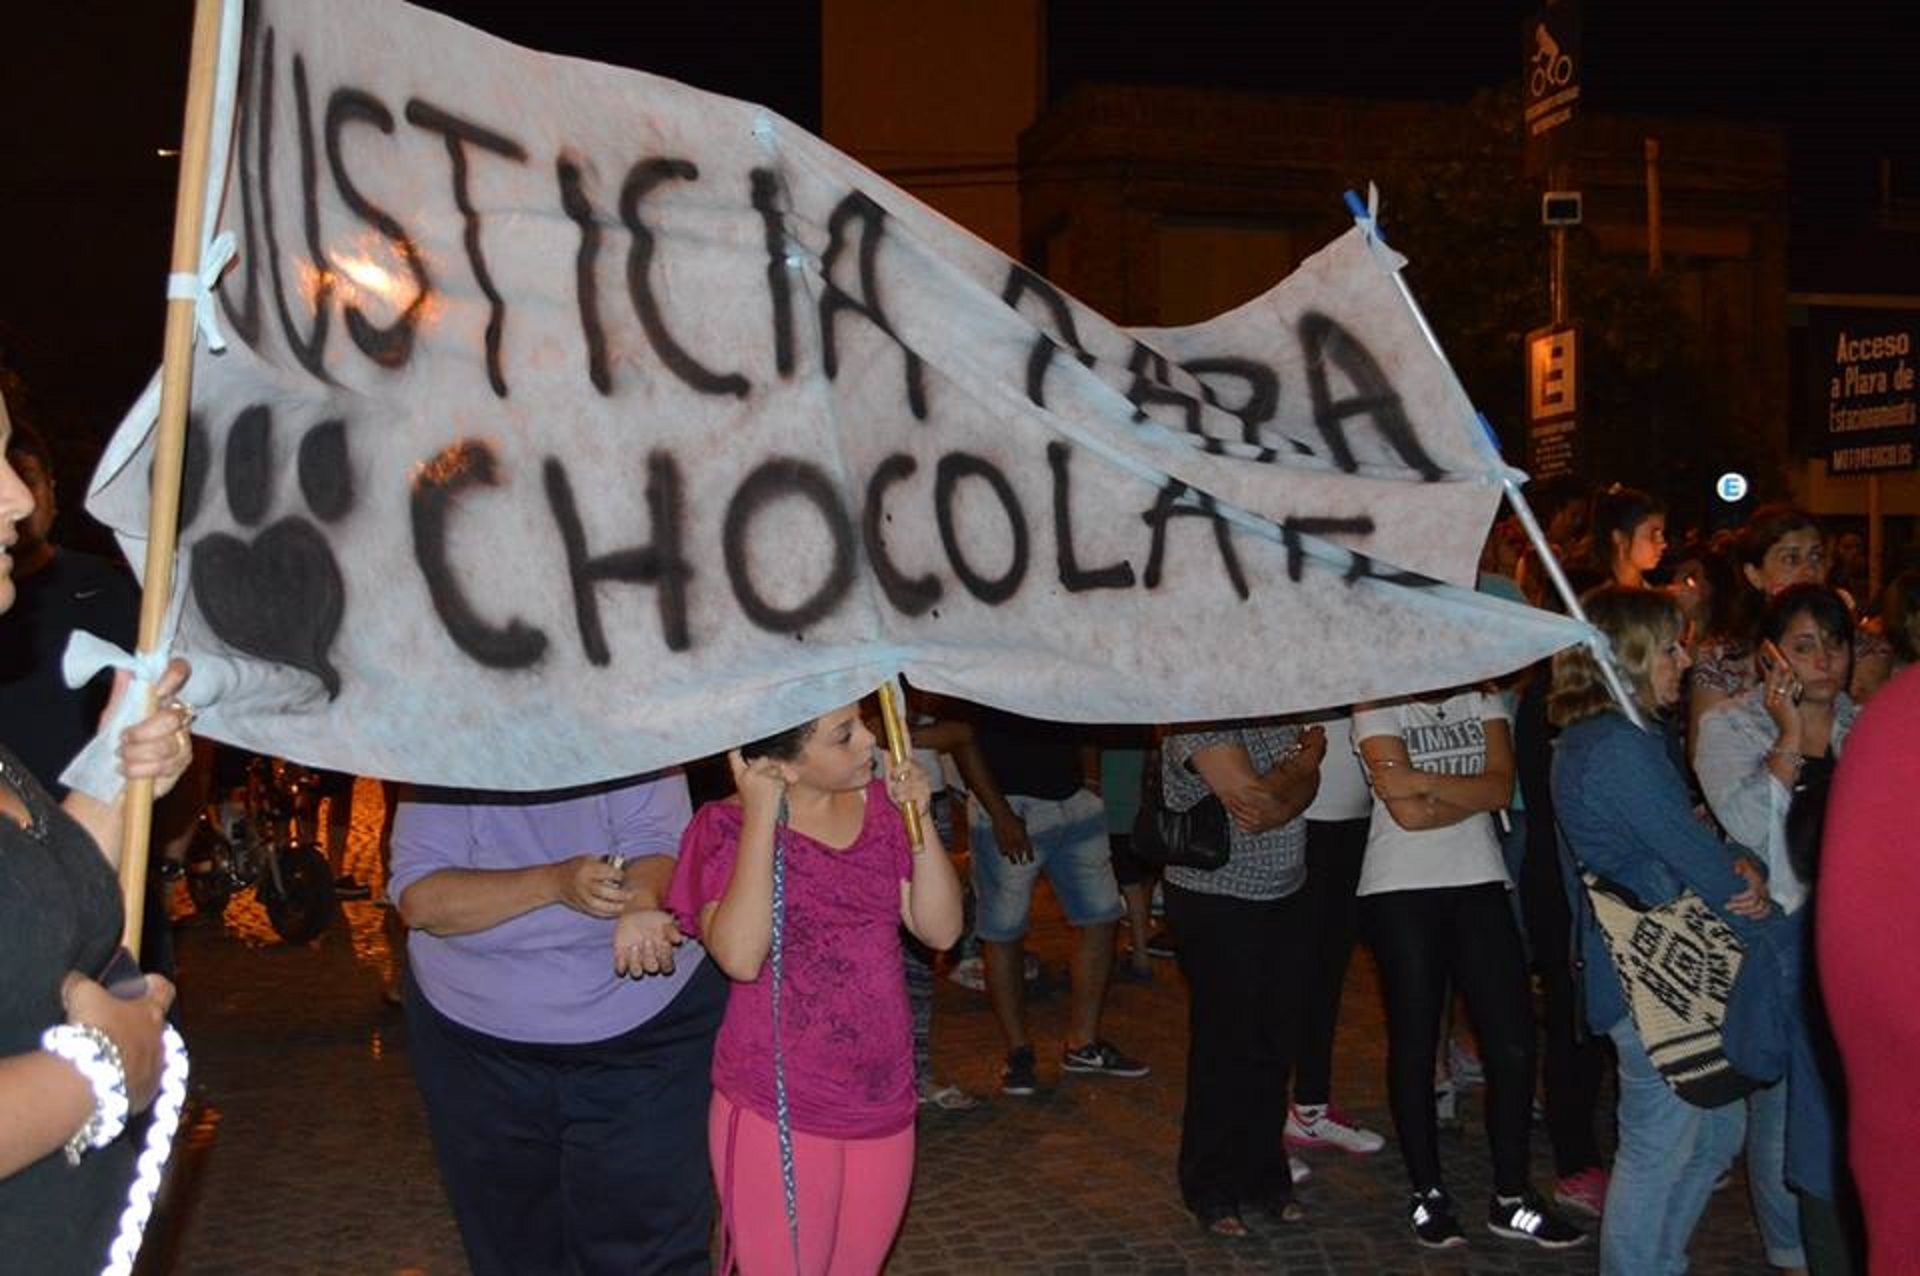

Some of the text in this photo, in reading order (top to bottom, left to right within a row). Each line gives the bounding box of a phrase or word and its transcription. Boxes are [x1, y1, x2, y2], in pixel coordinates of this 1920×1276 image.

[218, 0, 928, 421] JUSTICIA
[1836, 331, 1910, 364] Acceso
[1830, 359, 1915, 400] a Playa de
[1723, 478, 1740, 497] E
[1412, 754, 1485, 775] DITIO
